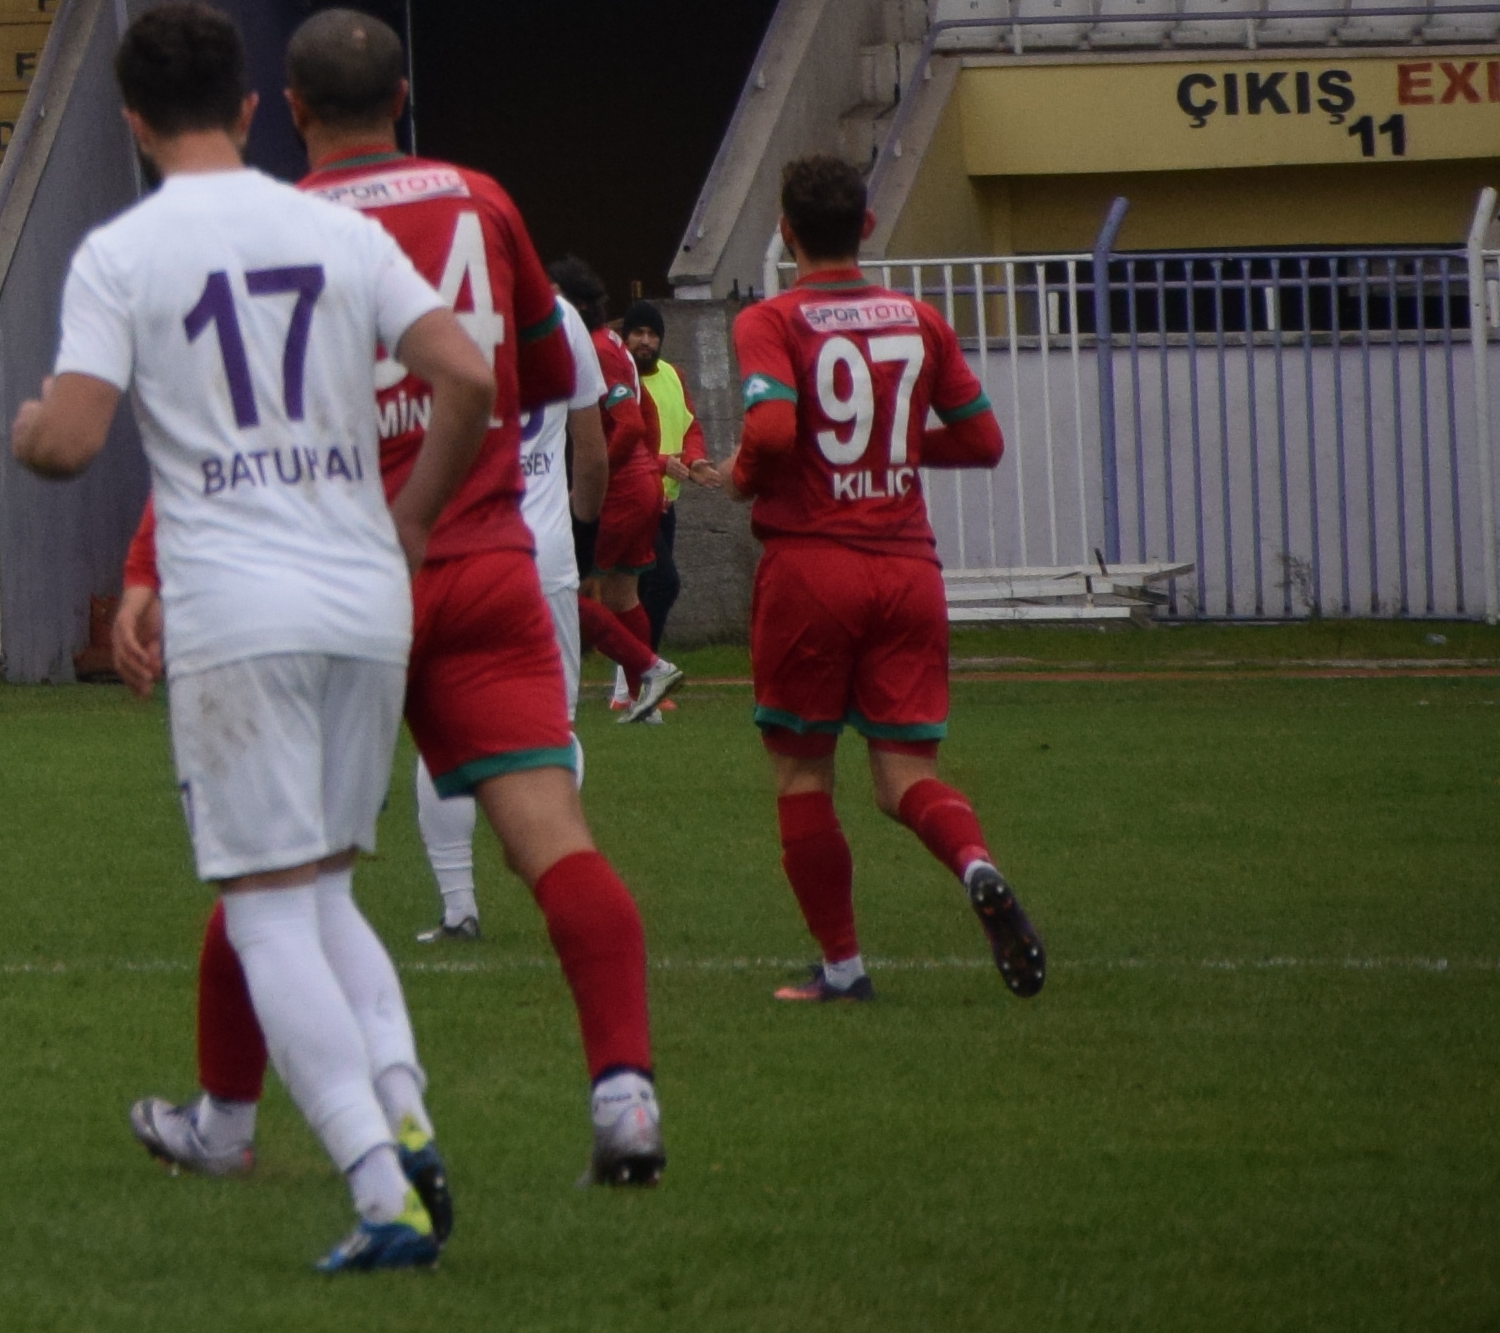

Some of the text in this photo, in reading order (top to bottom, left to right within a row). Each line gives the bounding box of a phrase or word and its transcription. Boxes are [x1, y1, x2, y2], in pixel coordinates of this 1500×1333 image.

[1177, 69, 1355, 129] ÇIKIŞ
[1348, 114, 1406, 157] 11
[183, 263, 325, 429] 17
[816, 334, 925, 466] 97
